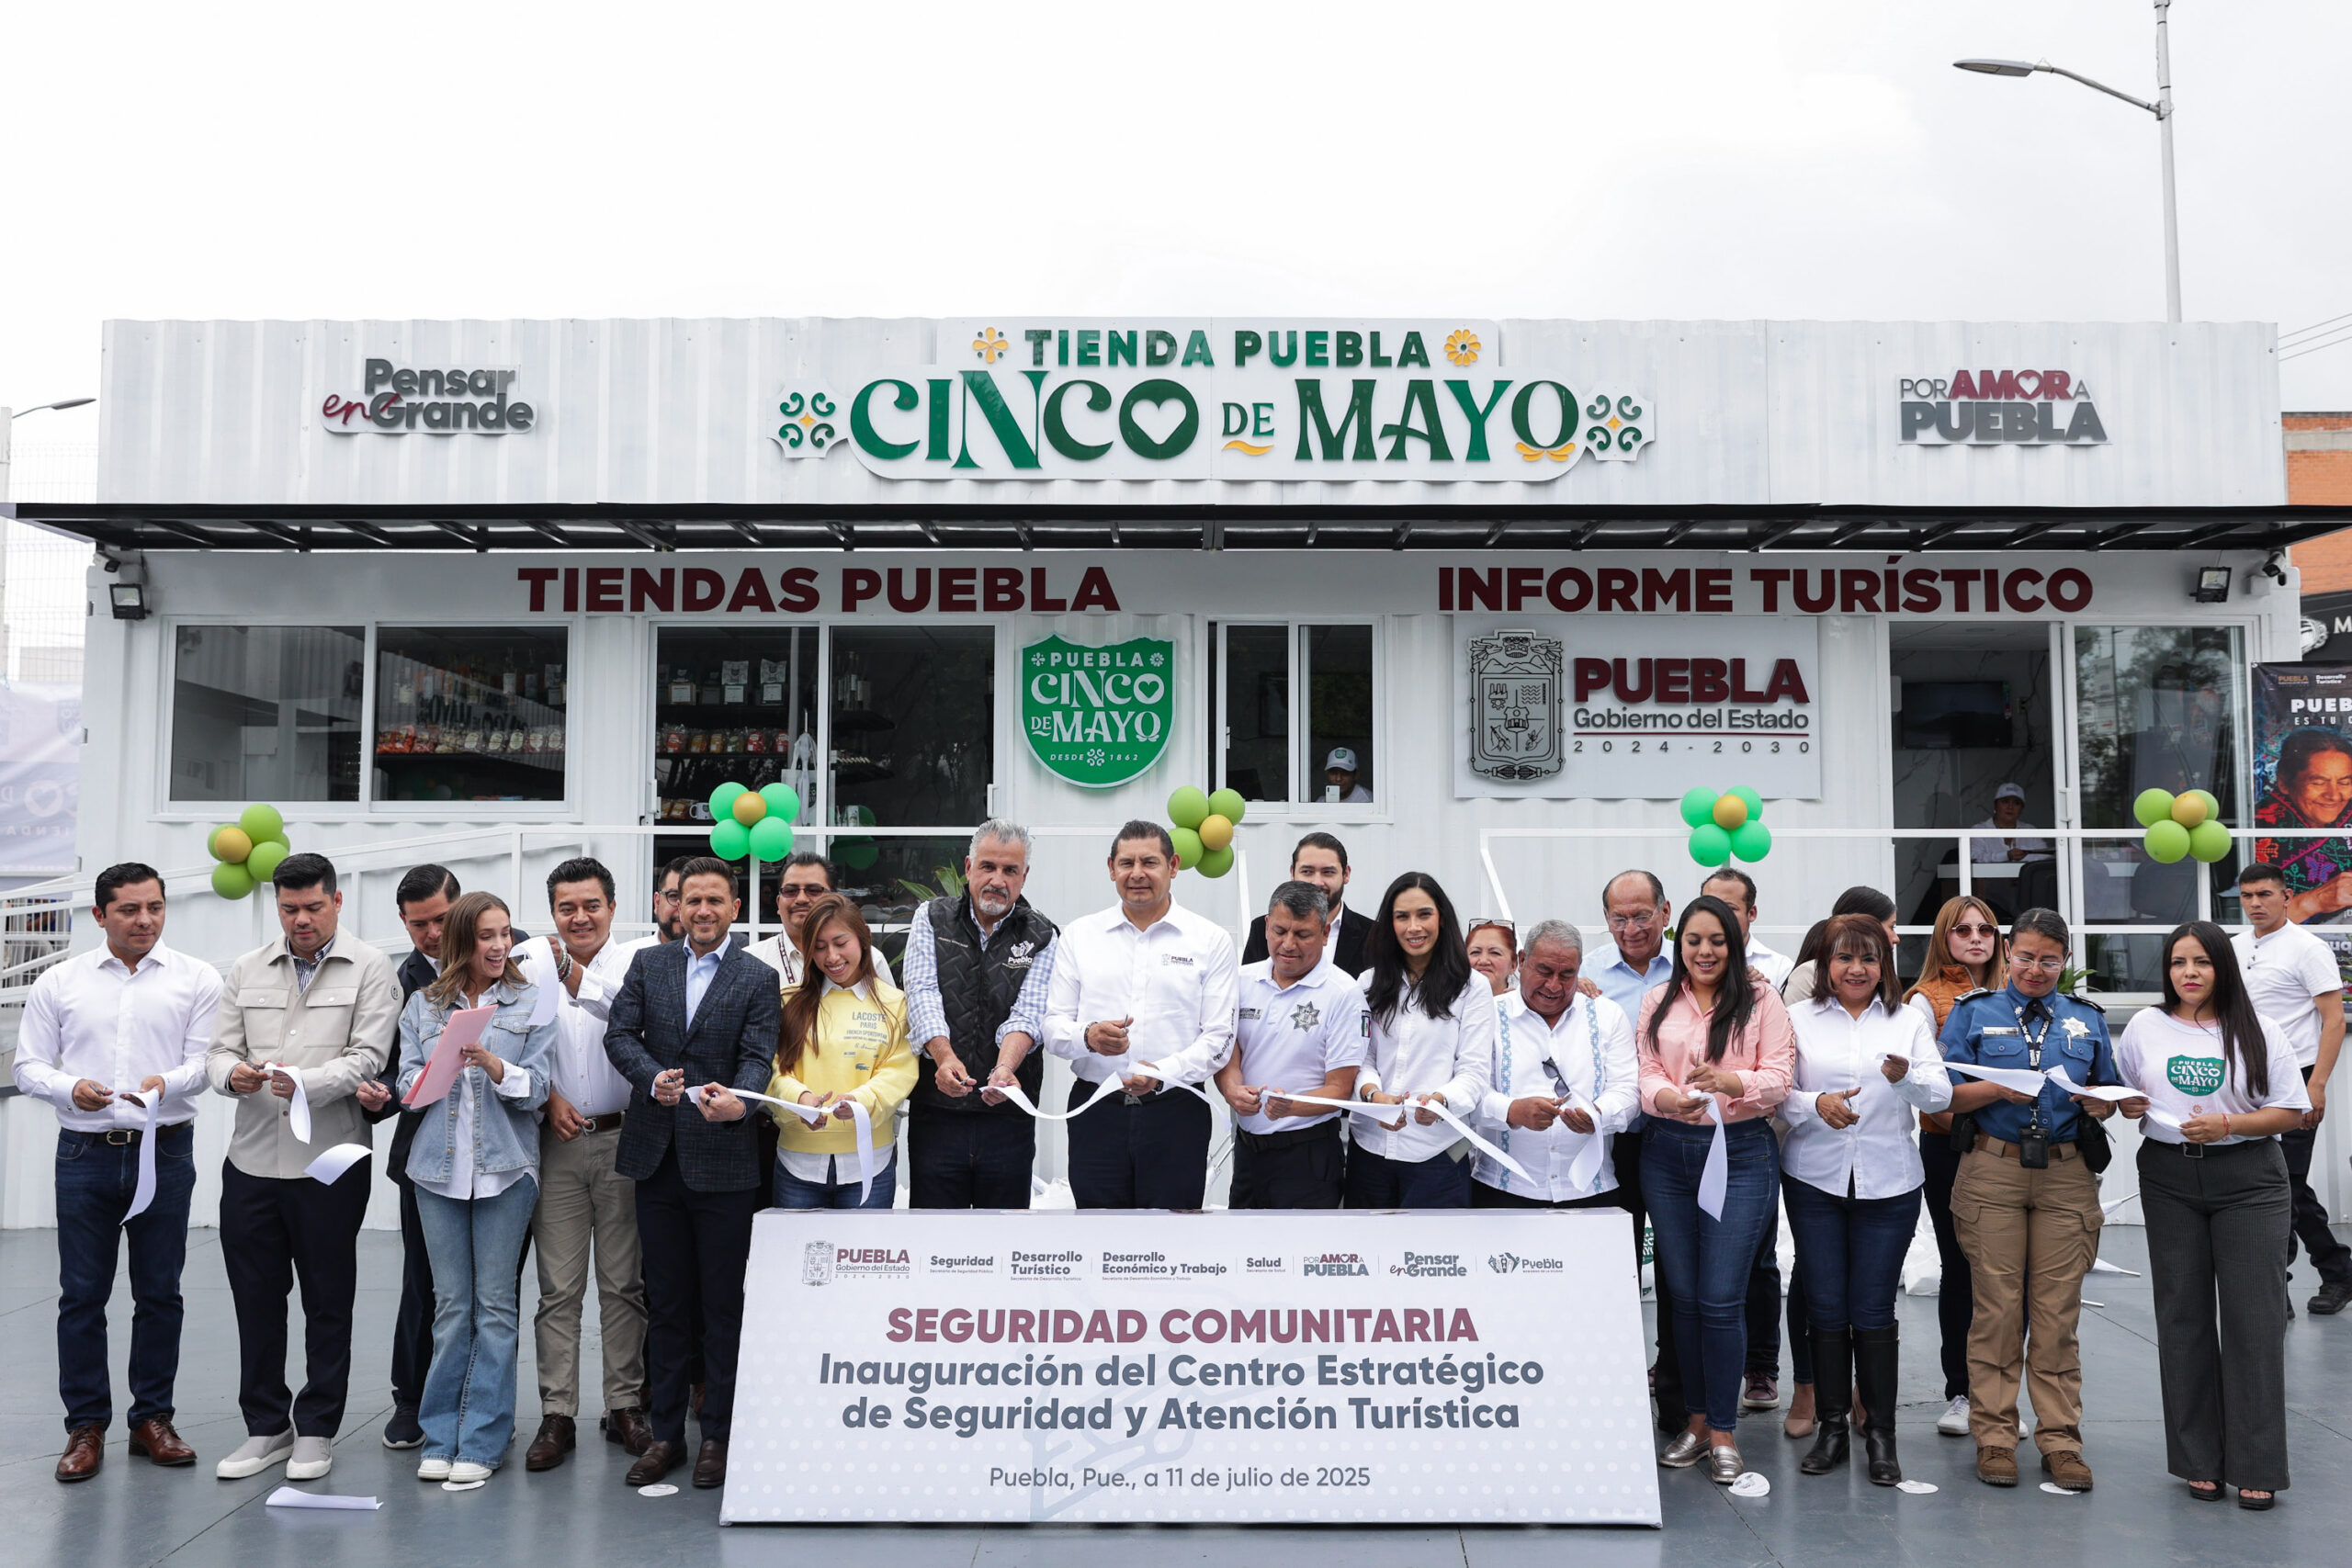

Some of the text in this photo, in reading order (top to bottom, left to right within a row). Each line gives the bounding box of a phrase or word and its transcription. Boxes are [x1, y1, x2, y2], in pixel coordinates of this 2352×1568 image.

[1024, 329, 1431, 368] TIENDA PUEBLA
[364, 356, 516, 395] Pensar
[1899, 368, 2090, 400] POR AMOR A
[369, 392, 534, 430] Grande
[850, 369, 1579, 470] CINCO DE MAYO
[1900, 400, 2108, 442] PUEBLA
[516, 566, 1122, 614] TIENDAS PUEBLA
[1438, 555, 2094, 614] INFORME TURÍSTICO
[1050, 651, 1145, 668] PUEBLA
[1573, 657, 1811, 704] PUEBLA
[1030, 670, 1165, 708] CINCO
[1573, 705, 1810, 730] Gobierno del Estado
[1030, 710, 1161, 743] DE MAYO
[1573, 740, 1811, 754] 2024-2030
[1049, 753, 1139, 761] DESDE 1862
[1008, 955, 1033, 964] Puebla
[852, 1011, 888, 1023] LACOSTE
[860, 1021, 877, 1030] PARIS
[2170, 1065, 2221, 1077] CINCO
[2178, 1075, 2219, 1088] MAYO
[836, 1248, 910, 1264] PUEBLA
[930, 1255, 994, 1269] Seguridad
[1011, 1251, 1083, 1263] Desarrollo
[1102, 1252, 1166, 1262] Desarrollo
[1246, 1257, 1282, 1268] Salud
[1303, 1256, 1320, 1264] POR
[1319, 1254, 1359, 1264] AMOR
[1404, 1251, 1460, 1266] Pensar
[1521, 1258, 1564, 1269] Puebla
[883, 1264, 910, 1272] Estado
[1011, 1263, 1071, 1275] Turístico
[1102, 1262, 1227, 1276] Económico y Trabajo
[1303, 1264, 1370, 1277] PUEBLA
[1407, 1264, 1468, 1278] Grande
[885, 1307, 1479, 1344] SEGURIDAD COMUNITARIA
[819, 1351, 1544, 1394] Inauguración del Centro Estratégico
[842, 1395, 1520, 1438] de Seguridad y Atención Turística
[989, 1466, 1372, 1491] Puebla, Pue., a 11 de julio de 2025
